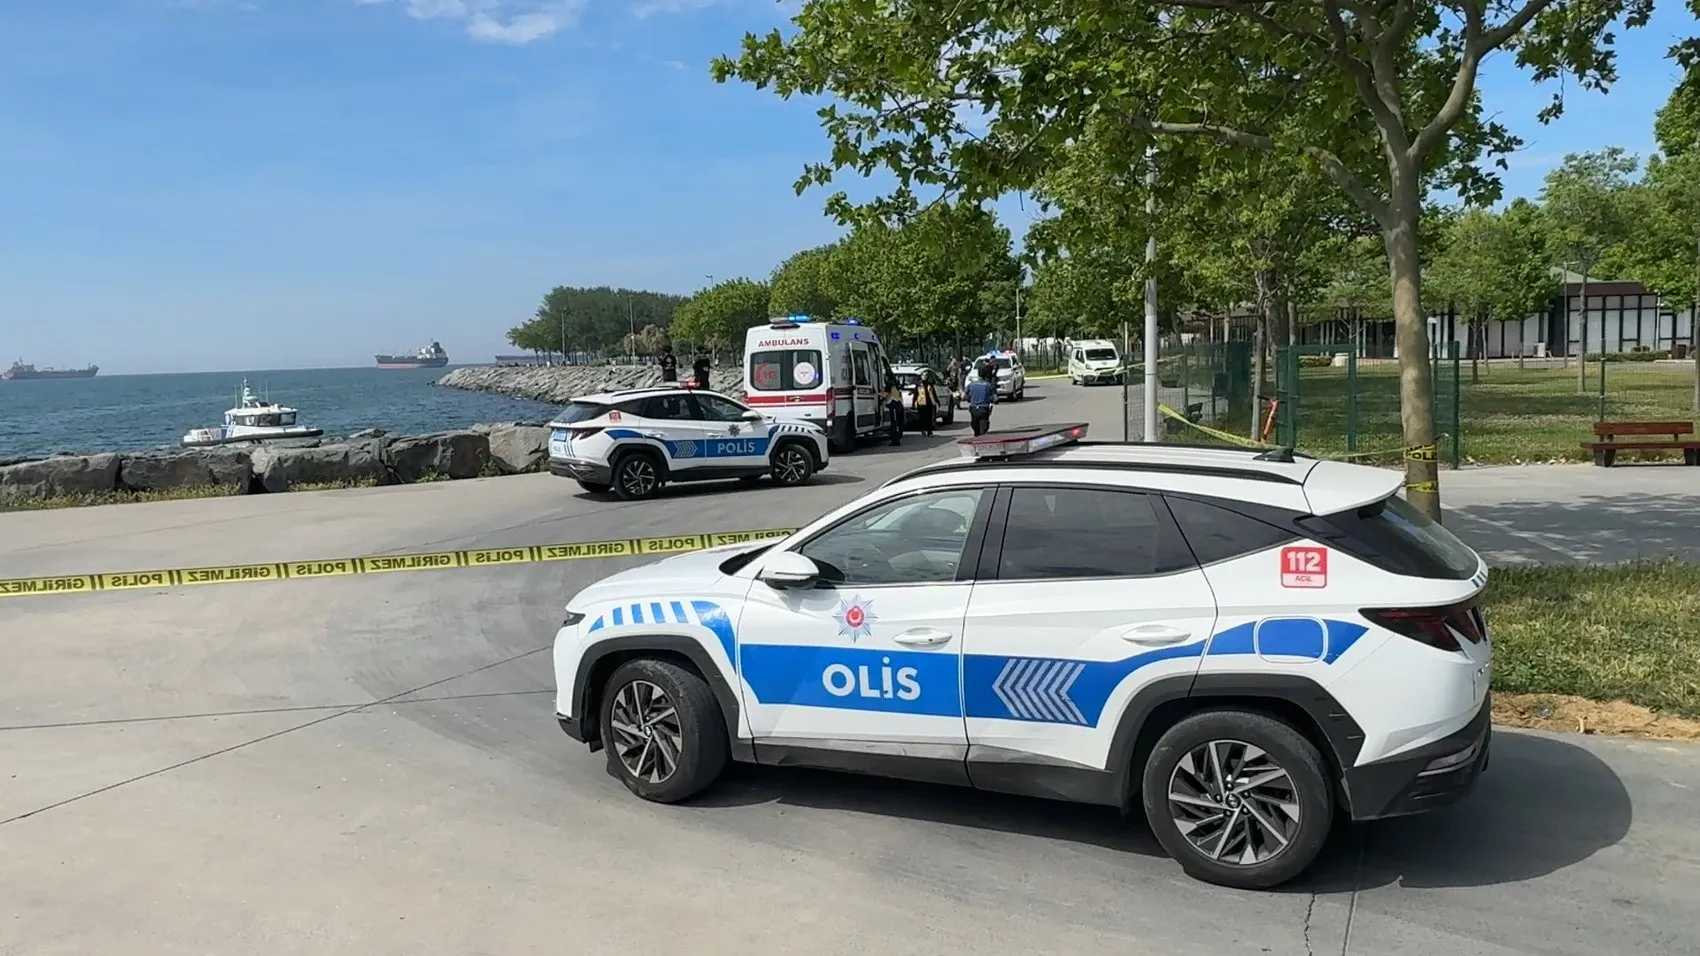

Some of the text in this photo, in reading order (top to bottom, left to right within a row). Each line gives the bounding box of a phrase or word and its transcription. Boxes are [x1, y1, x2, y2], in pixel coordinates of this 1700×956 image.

[758, 338, 810, 348] AMBULANS
[1286, 551, 1322, 572] 112
[821, 656, 921, 700] OLİS
